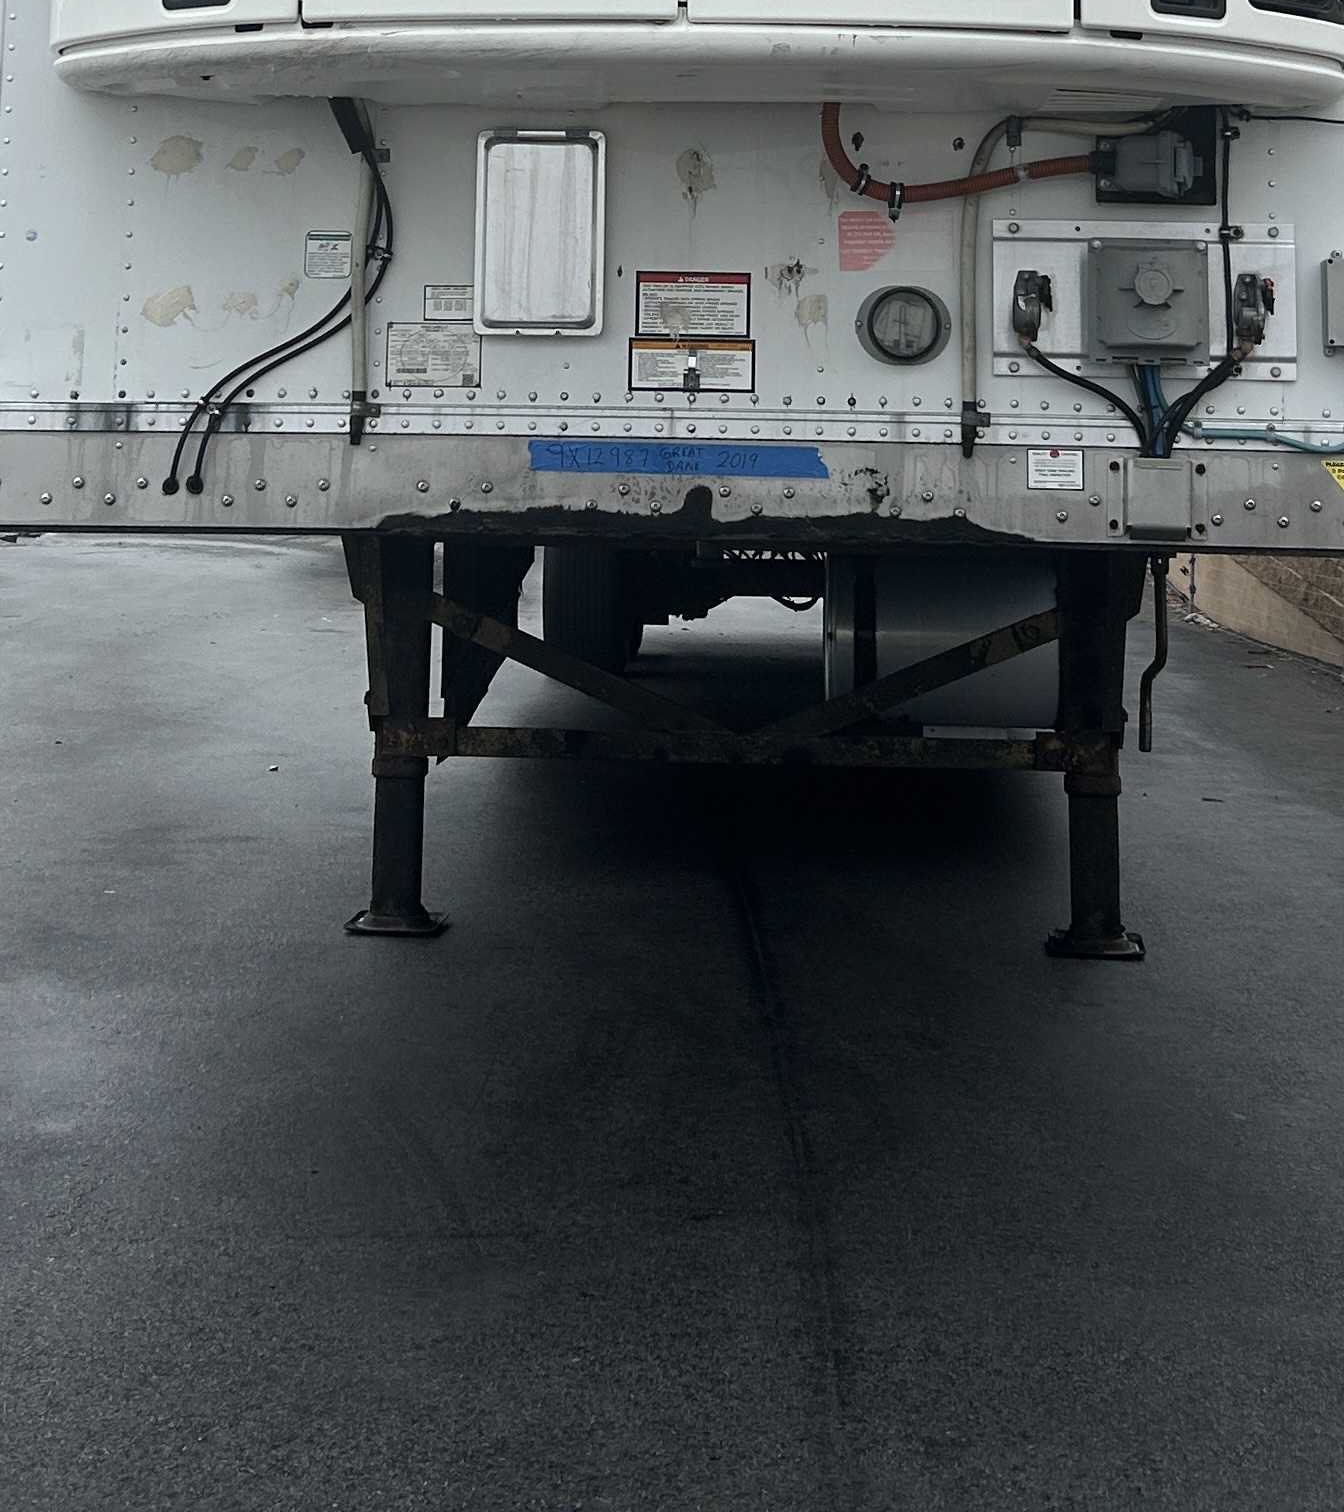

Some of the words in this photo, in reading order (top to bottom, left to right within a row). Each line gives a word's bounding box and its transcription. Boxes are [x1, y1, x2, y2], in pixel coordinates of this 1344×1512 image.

[659, 445, 706, 460] GREAT
[717, 450, 759, 470] 2019
[666, 460, 701, 473] DANE
